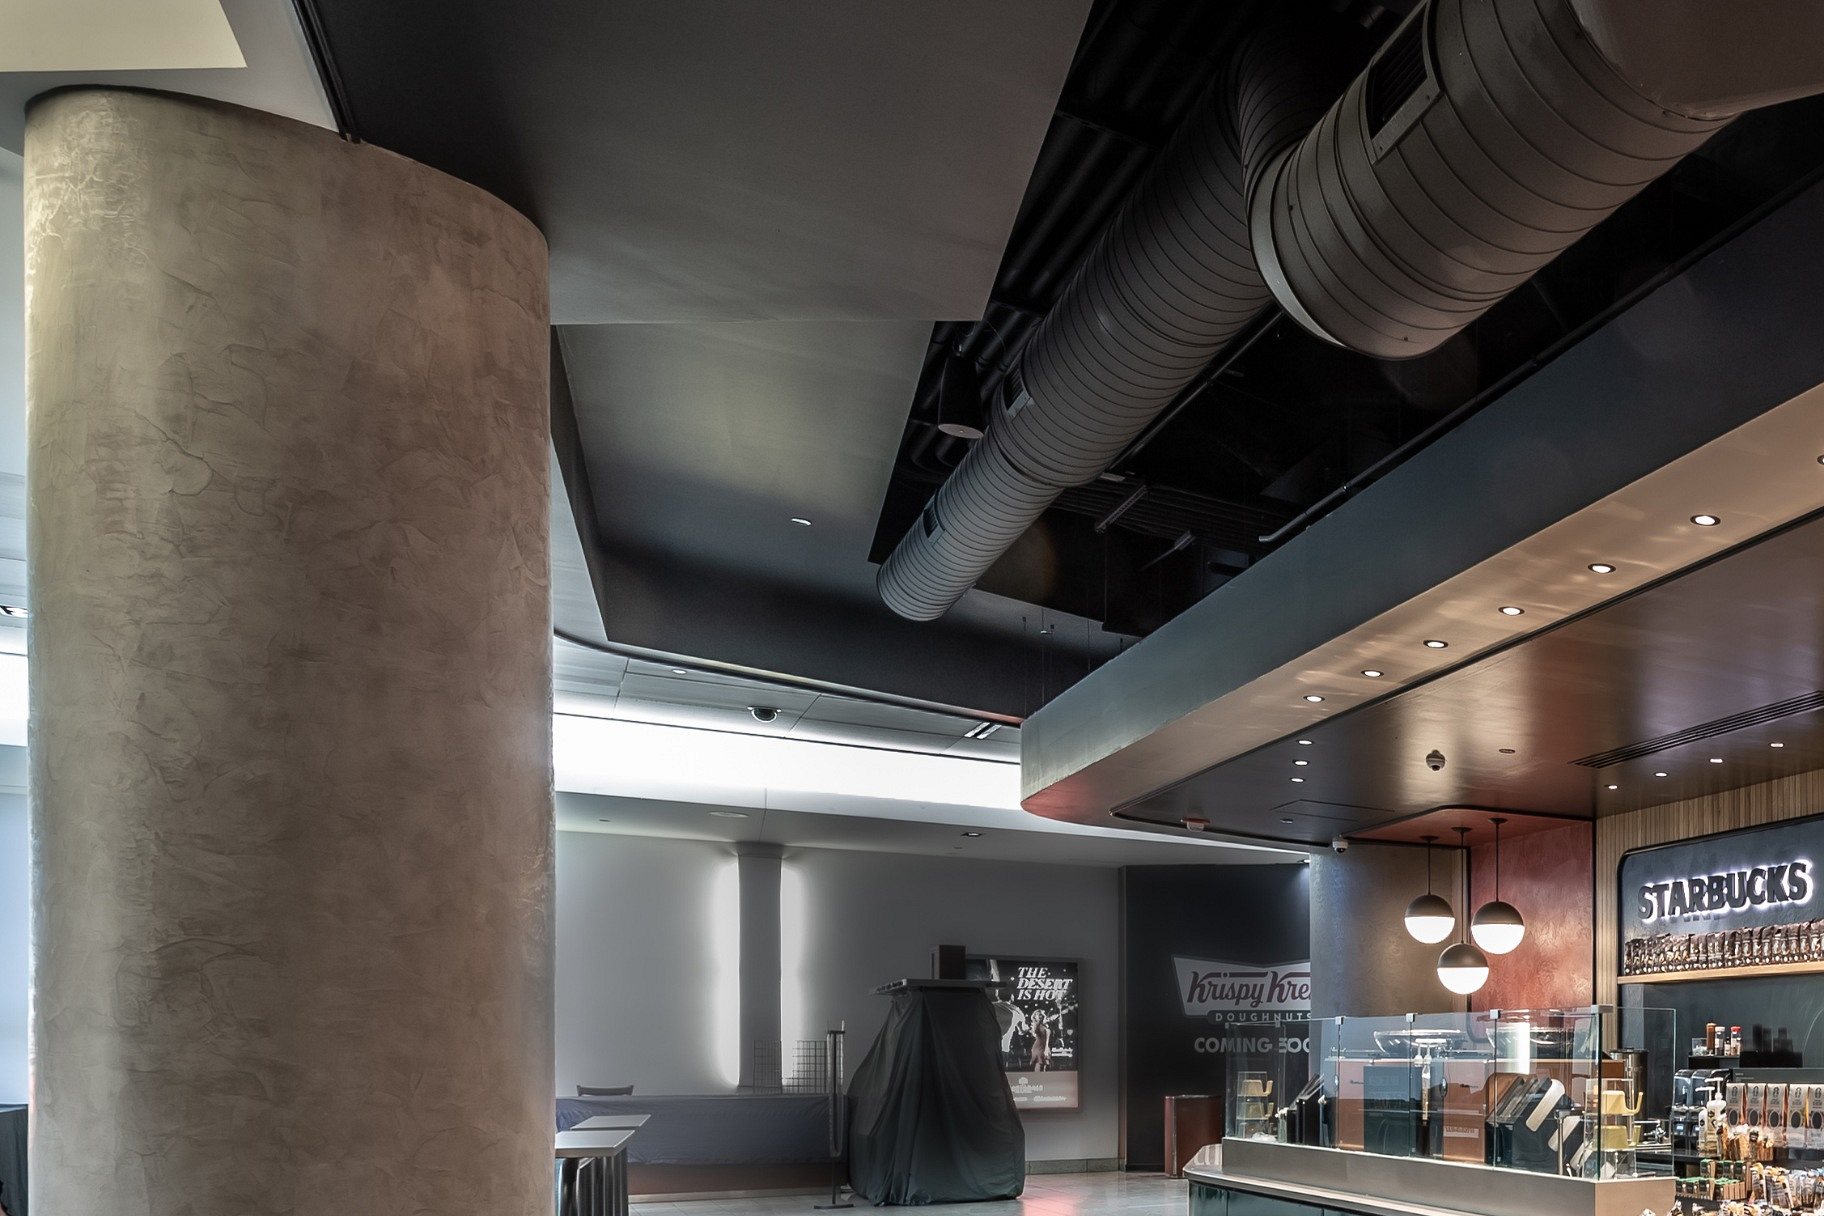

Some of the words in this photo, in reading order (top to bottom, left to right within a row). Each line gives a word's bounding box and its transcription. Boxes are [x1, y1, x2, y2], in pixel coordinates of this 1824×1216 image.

[1637, 862, 1808, 919] STARBUCKS
[1018, 967, 1048, 978] THE
[1017, 978, 1073, 989] DESERT
[1187, 971, 1269, 1008] Krispy
[1017, 990, 1032, 1000] IS
[1194, 1037, 1272, 1053] COMING
